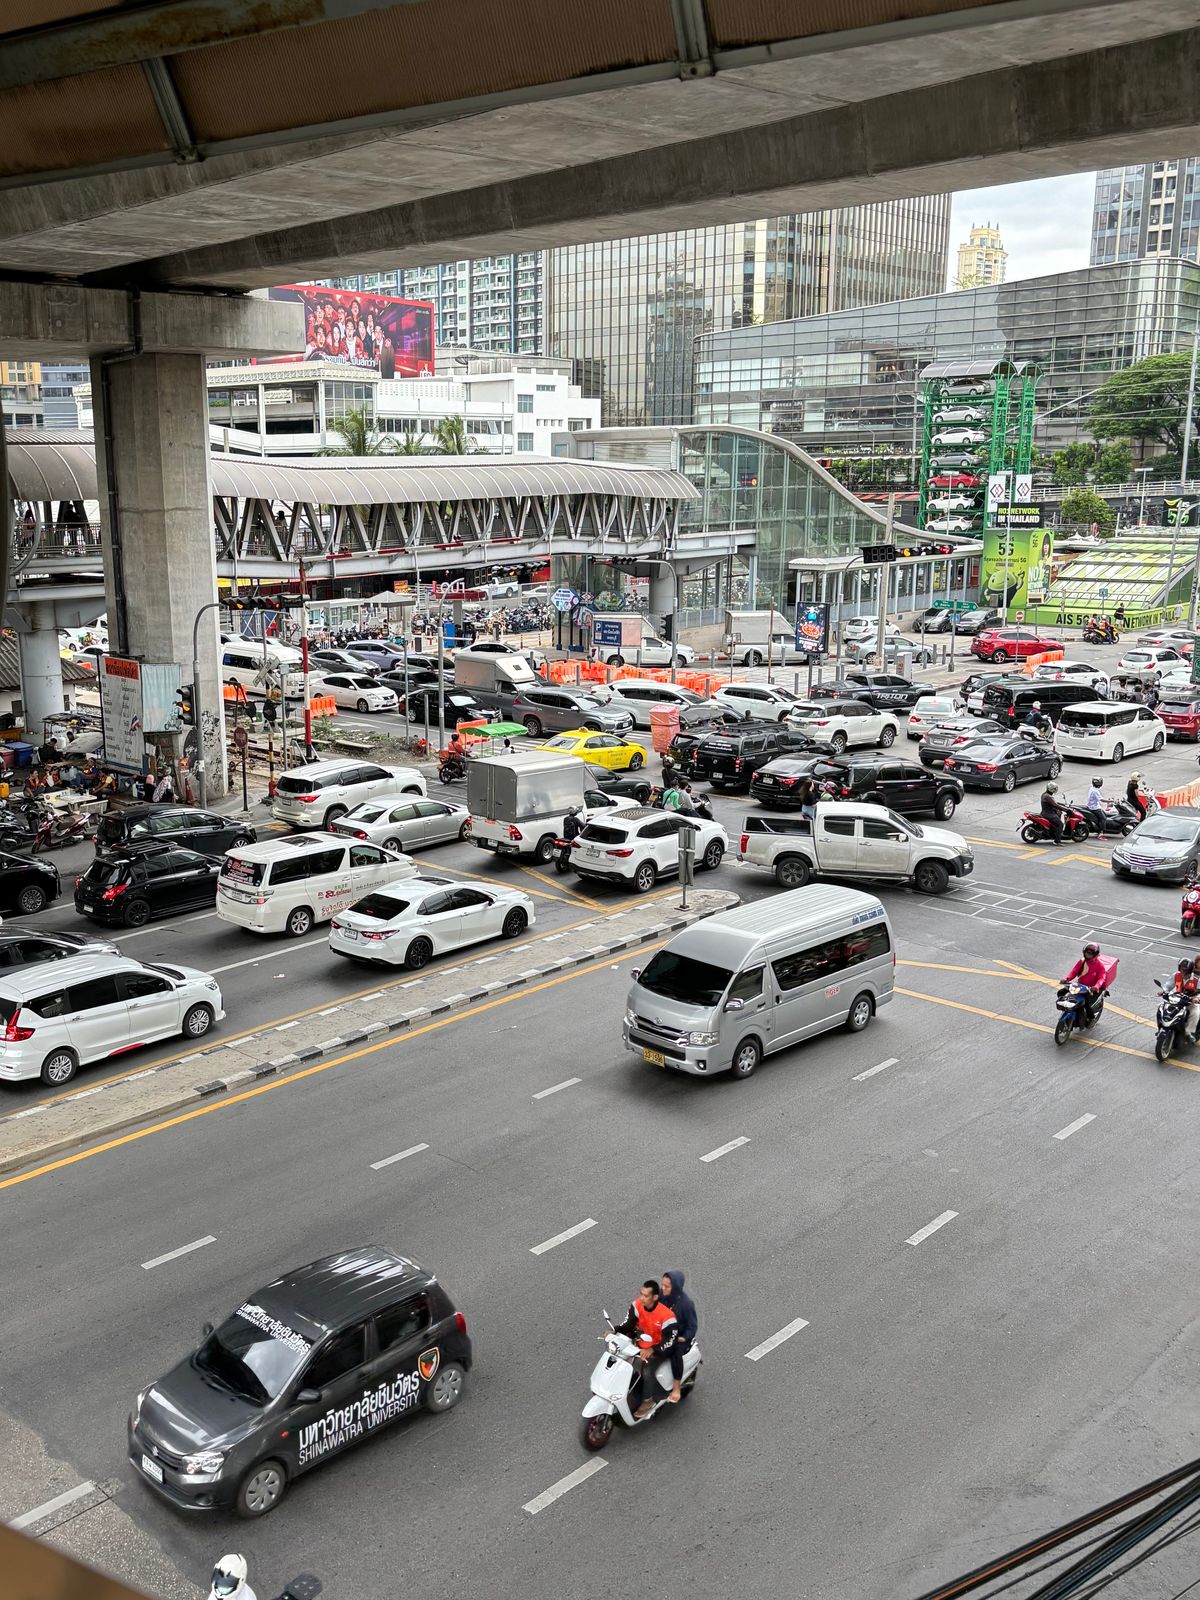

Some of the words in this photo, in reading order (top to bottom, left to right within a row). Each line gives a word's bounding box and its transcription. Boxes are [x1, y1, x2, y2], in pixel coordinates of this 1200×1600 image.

[1056, 614, 1074, 625] AIS
[1123, 612, 1152, 629] NETWORK
[236, 1310, 270, 1332] SHINAWATRA
[270, 1331, 308, 1355] UNIVERSITY
[299, 1421, 363, 1465] SHINAWATRA
[367, 1390, 420, 1429] UNIVERSITY
[300, 1371, 420, 1450] มหาวิทยาลัยชินวัตร
